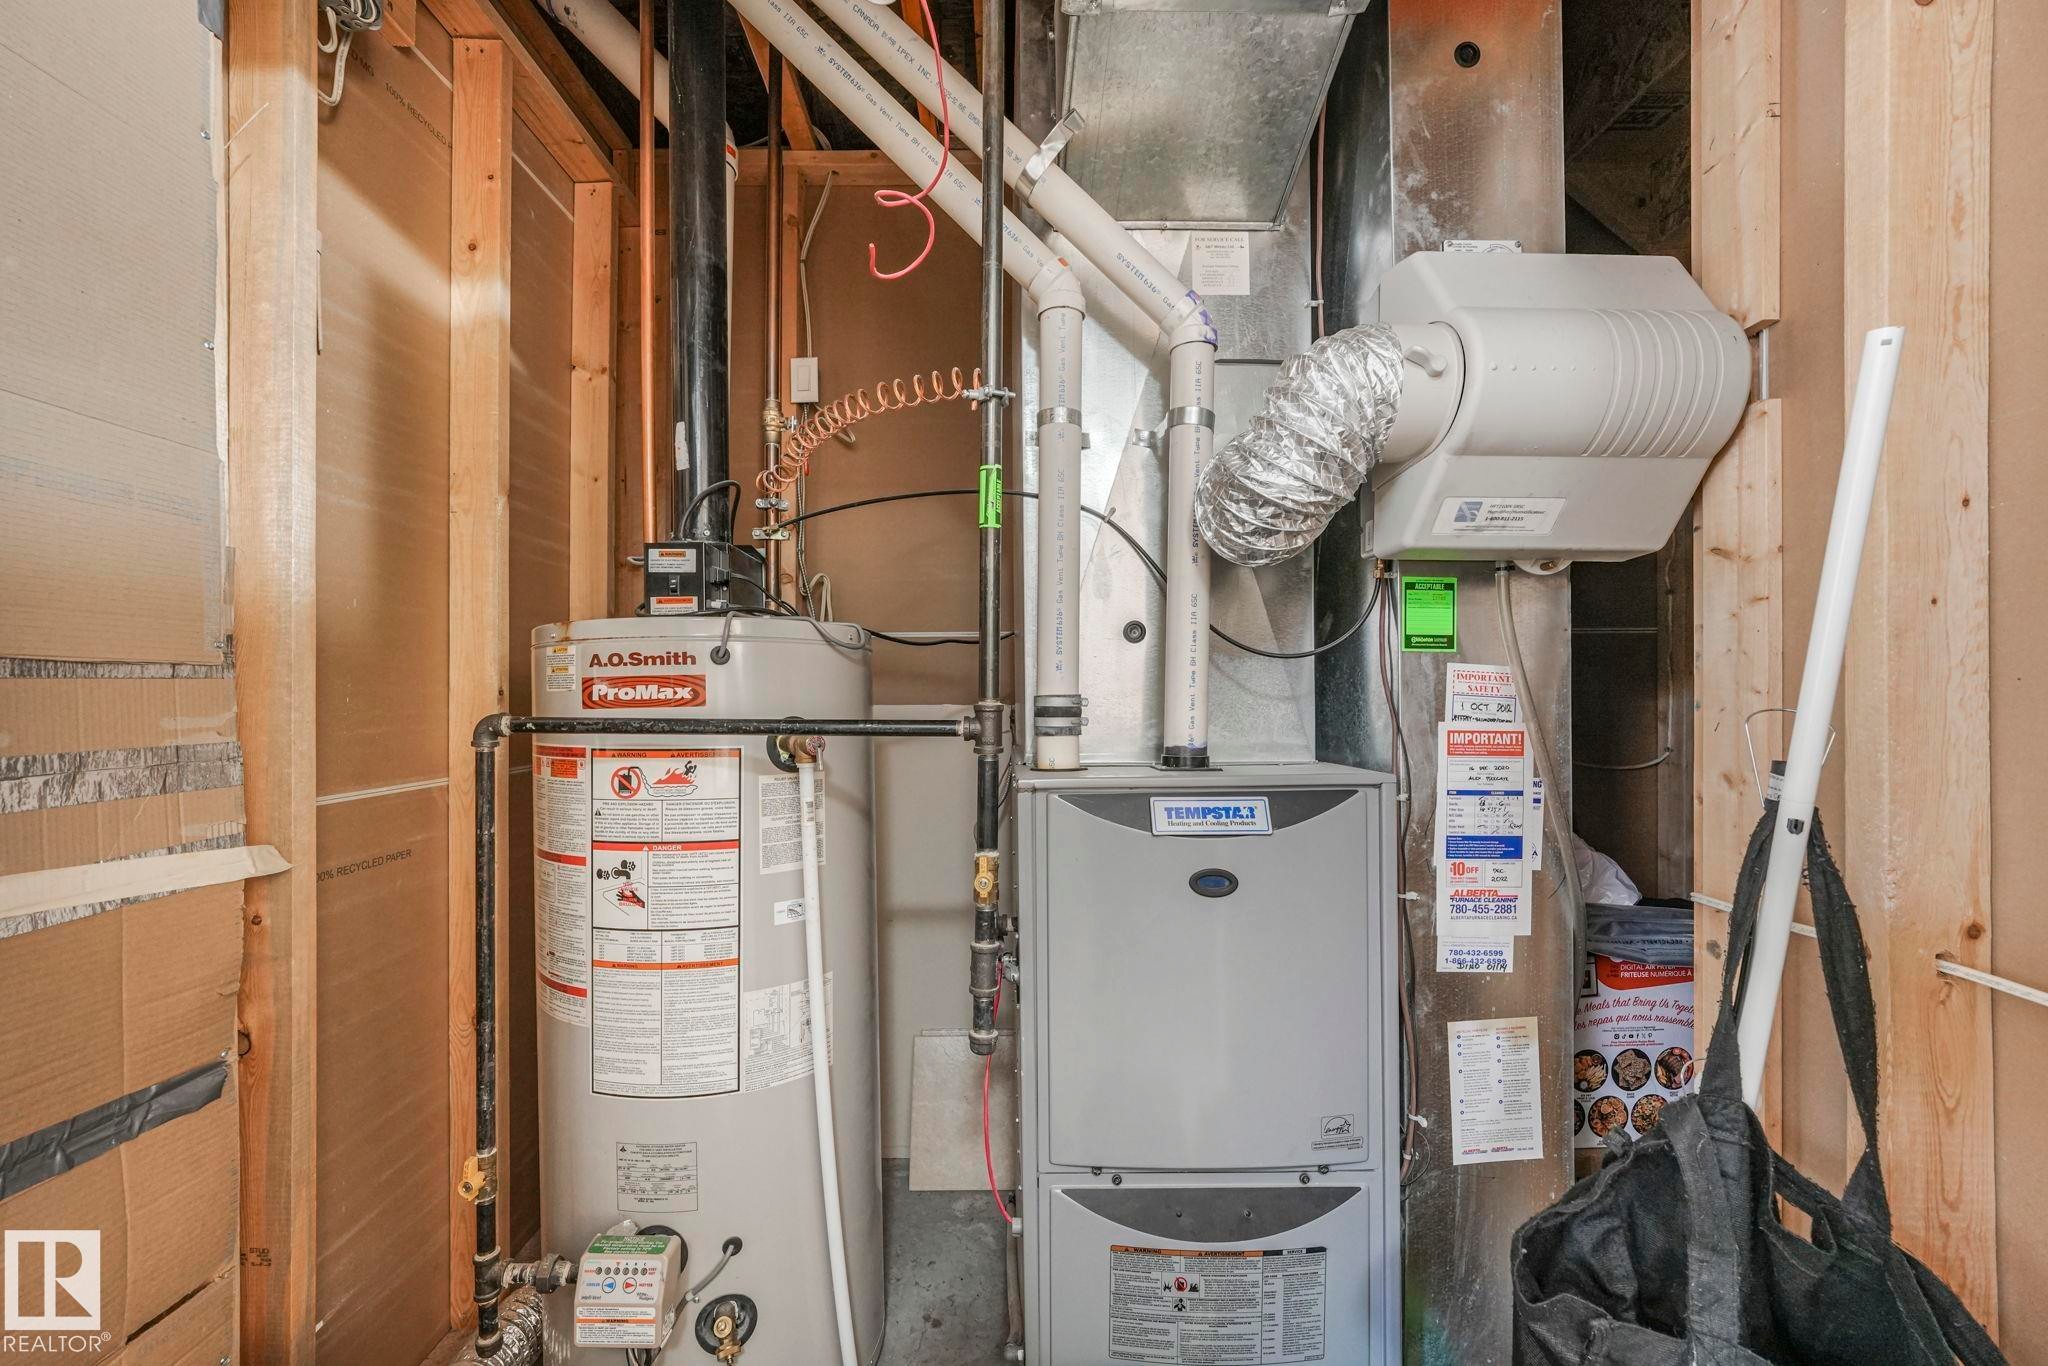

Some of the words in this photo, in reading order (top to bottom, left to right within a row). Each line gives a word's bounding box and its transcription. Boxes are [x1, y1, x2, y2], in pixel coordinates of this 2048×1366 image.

[852, 4, 881, 33] CANADA
[896, 44, 915, 64] IPEX
[406, 103, 447, 146] RECYCLED
[865, 93, 878, 107] Gas
[879, 106, 894, 122] Vent
[896, 121, 911, 138] Type
[920, 146, 940, 167] Class
[1022, 244, 1035, 259] Gas
[1193, 435, 1201, 457] Type
[1057, 504, 1065, 528] Class
[1056, 567, 1064, 586] Vent
[1055, 590, 1064, 605] Gas
[1190, 629, 1198, 653] Class
[589, 651, 697, 668] A.O.Smith
[1188, 670, 1197, 689] Type
[592, 684, 694, 701] ProMax
[1467, 685, 1502, 693] SAFETY
[1188, 693, 1196, 712] Vent
[1188, 715, 1196, 730] Gas
[1449, 733, 1522, 745] IMPORTANT!
[336, 856, 384, 877] RECYCLED
[385, 848, 412, 865] PAPER
[1466, 866, 1479, 874] OFF
[1452, 889, 1499, 898] ALBERTA
[1450, 904, 1517, 914] 780-455-2881
[1445, 957, 1507, 965] 1-866-432-6599
[1620, 963, 1644, 971] DIGITAL
[1650, 969, 1687, 978] NUMÉRIQUE
[1584, 999, 1611, 1013] Meals
[1612, 996, 1631, 1008] that
[1632, 996, 1657, 1011] Bring
[1659, 998, 1670, 1009] Us
[1587, 1014, 1614, 1027] repas
[1615, 1013, 1630, 1025] qui
[1631, 1013, 1653, 1023] nous
